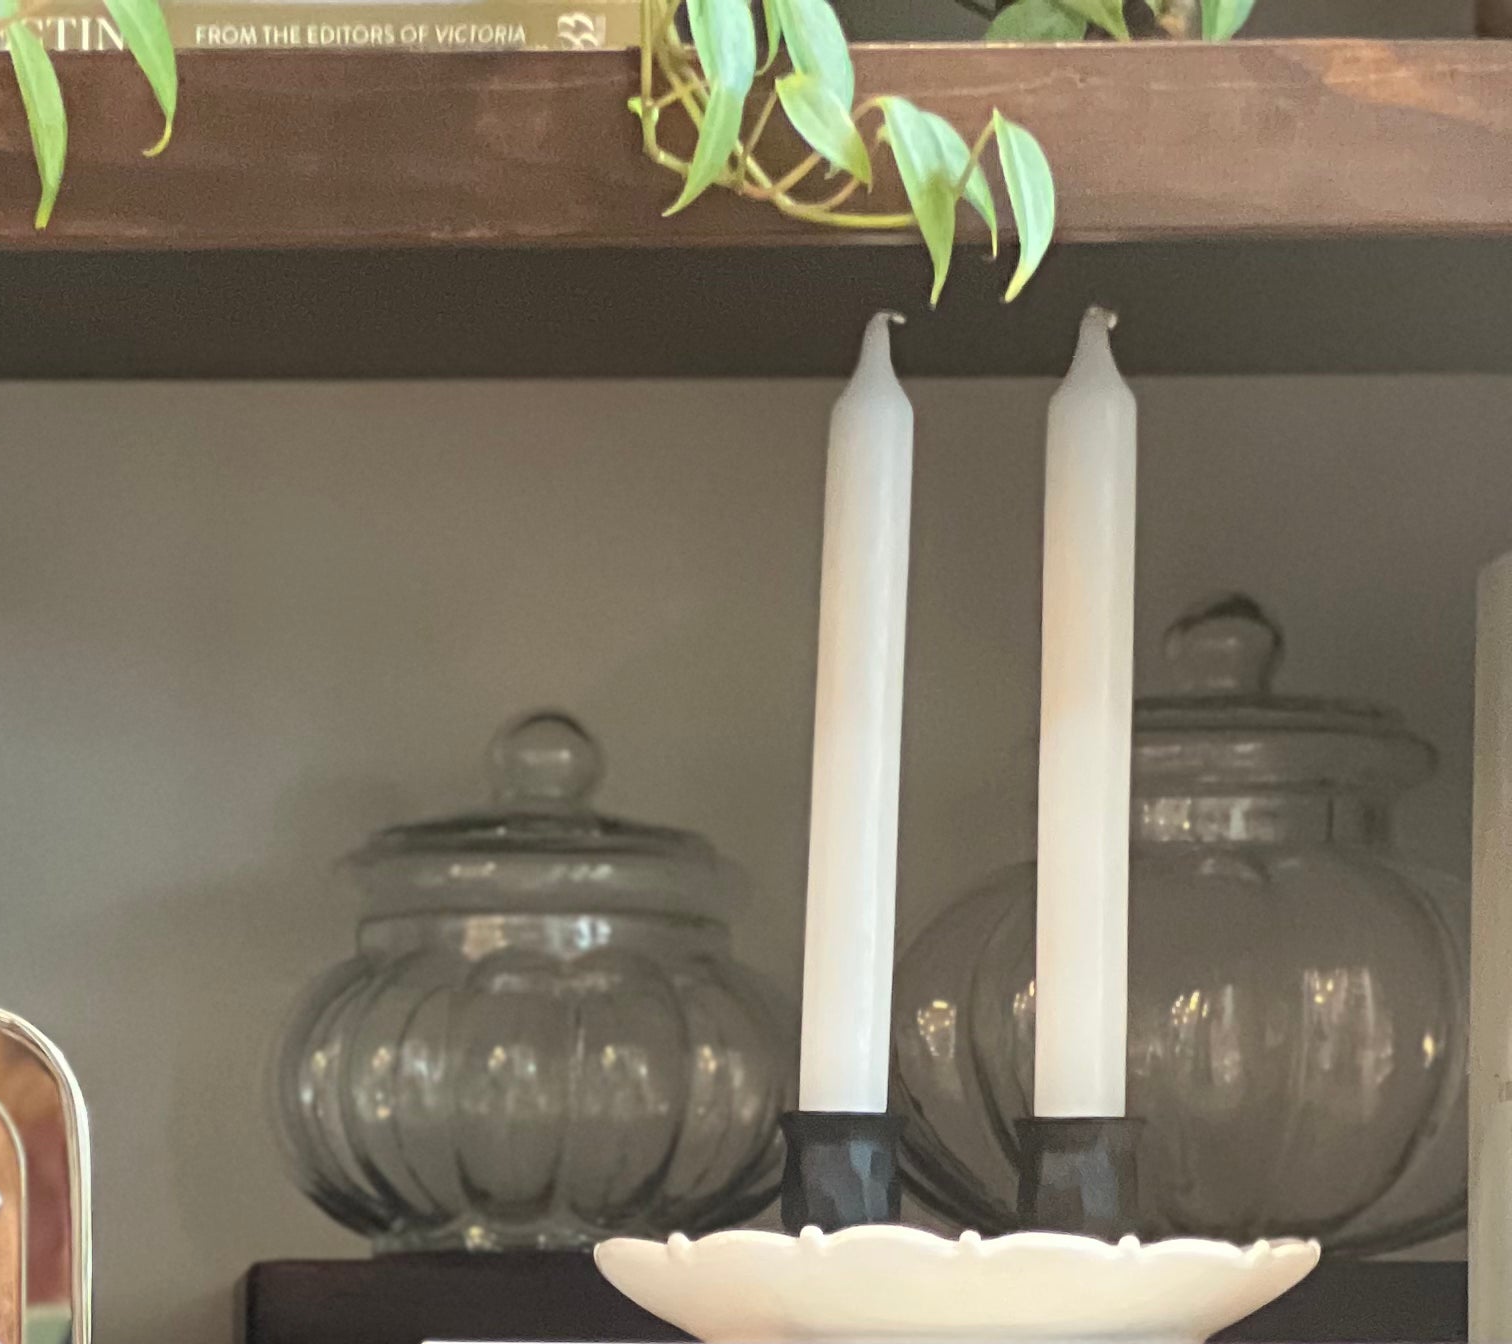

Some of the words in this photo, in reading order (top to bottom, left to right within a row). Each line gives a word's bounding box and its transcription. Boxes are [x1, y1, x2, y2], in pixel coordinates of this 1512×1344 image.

[194, 24, 257, 46] FROM
[262, 24, 301, 46] THE
[307, 24, 395, 46] EDITORS
[400, 24, 428, 46] OF
[434, 24, 526, 47] VICTORIA
